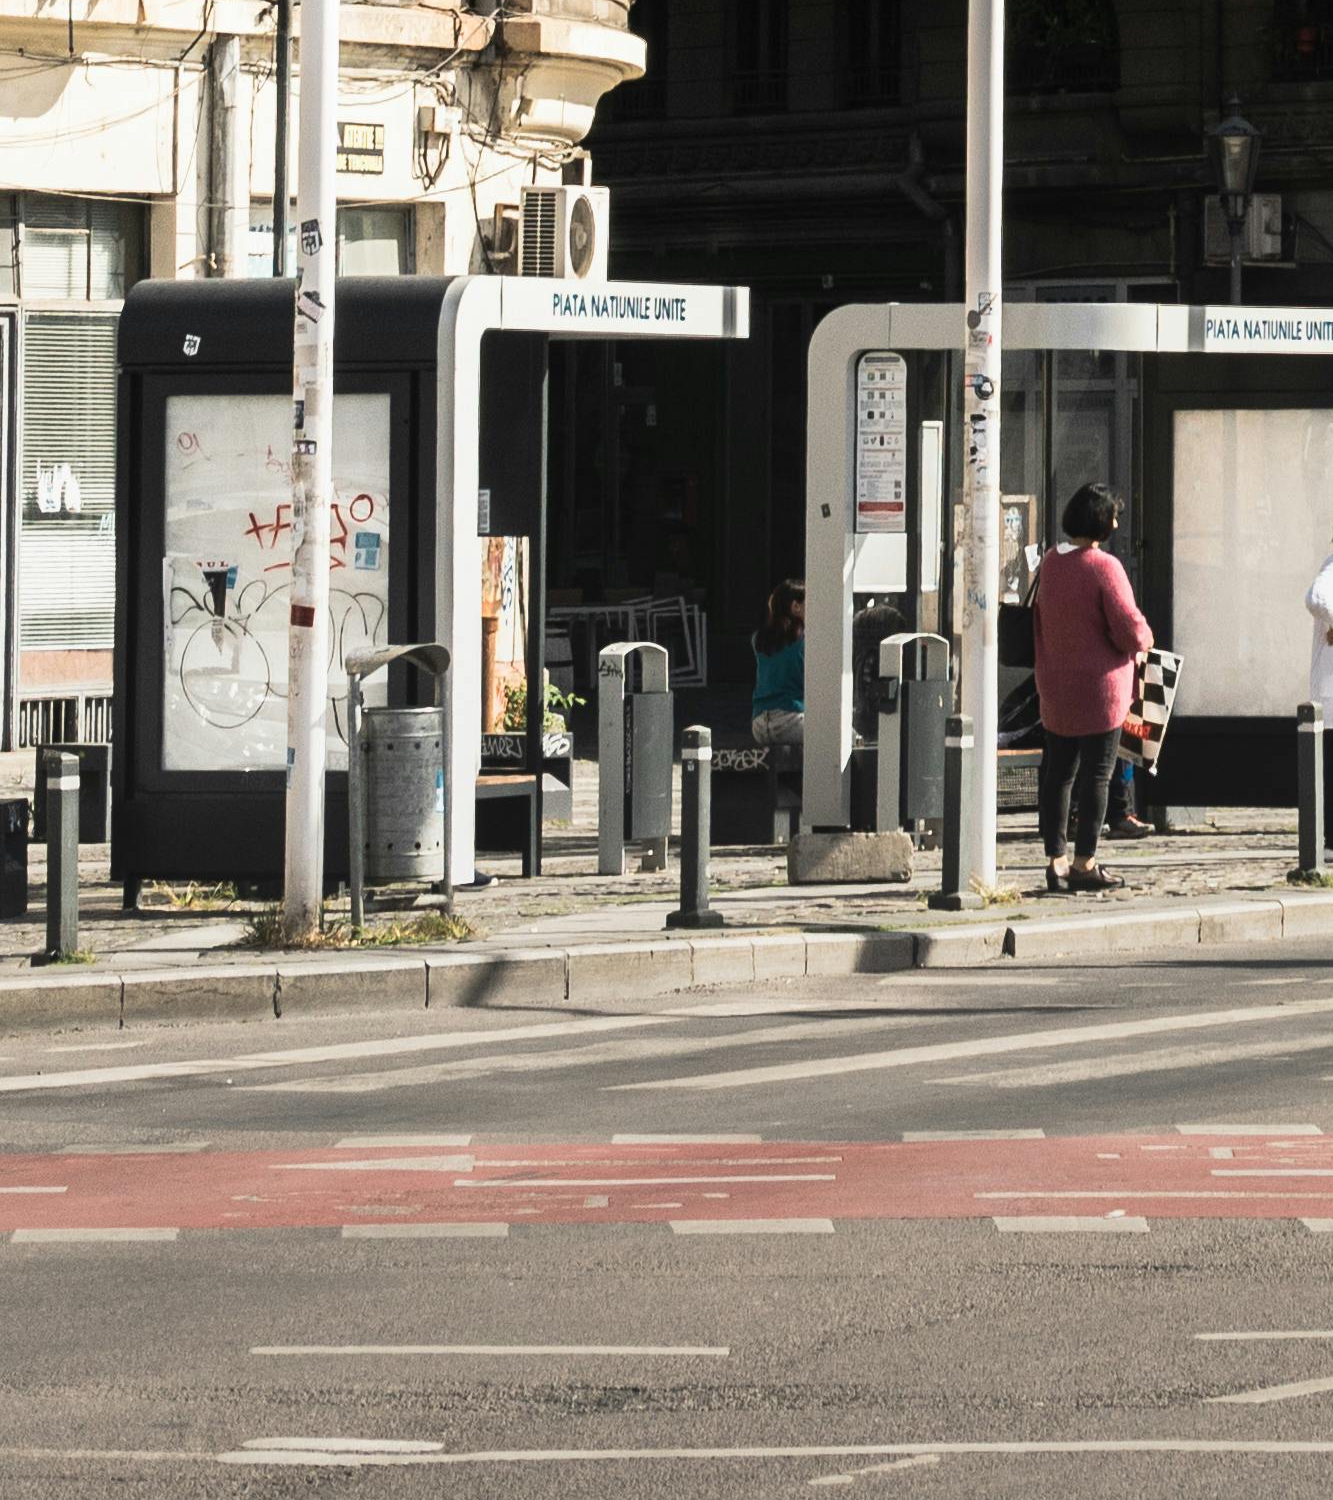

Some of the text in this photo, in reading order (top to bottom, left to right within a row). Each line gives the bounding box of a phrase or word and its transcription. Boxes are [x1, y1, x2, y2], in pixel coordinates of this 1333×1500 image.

[552, 292, 687, 322] PIATA NATIUNILE UNITE
[1205, 319, 1240, 339] PIATA
[1243, 319, 1303, 341] NATIUNILE
